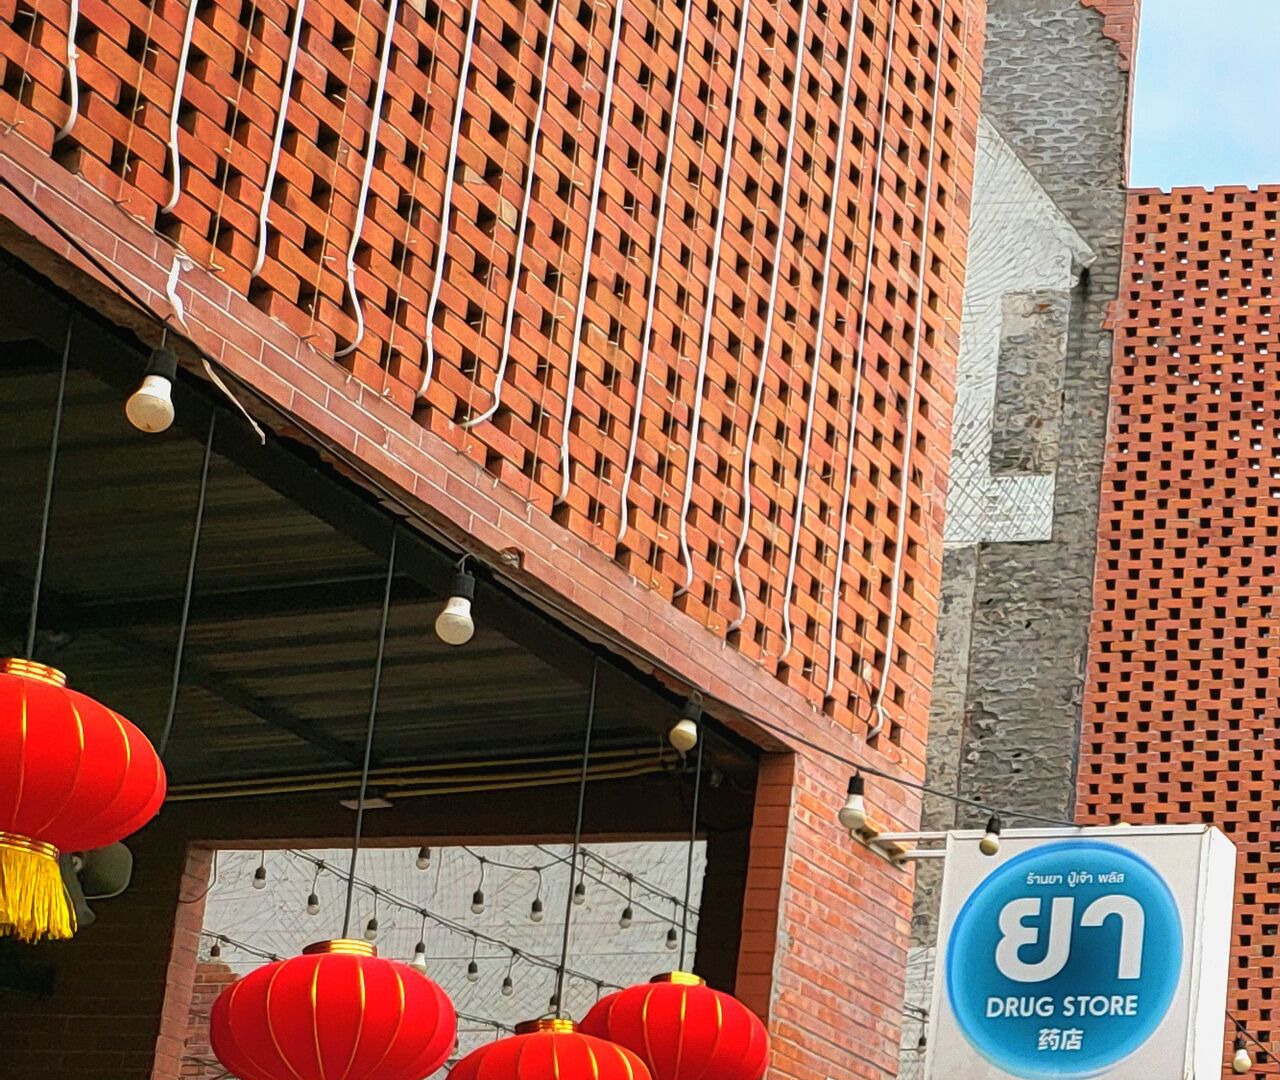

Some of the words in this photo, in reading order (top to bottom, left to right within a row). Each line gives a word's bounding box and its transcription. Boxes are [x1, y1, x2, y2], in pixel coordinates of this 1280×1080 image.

[1026, 872, 1064, 885] ร้านยา
[995, 893, 1146, 983] ยา
[986, 997, 1055, 1018] DRUG
[1063, 995, 1138, 1017] STORE
[1037, 1028, 1084, 1051] 药店
